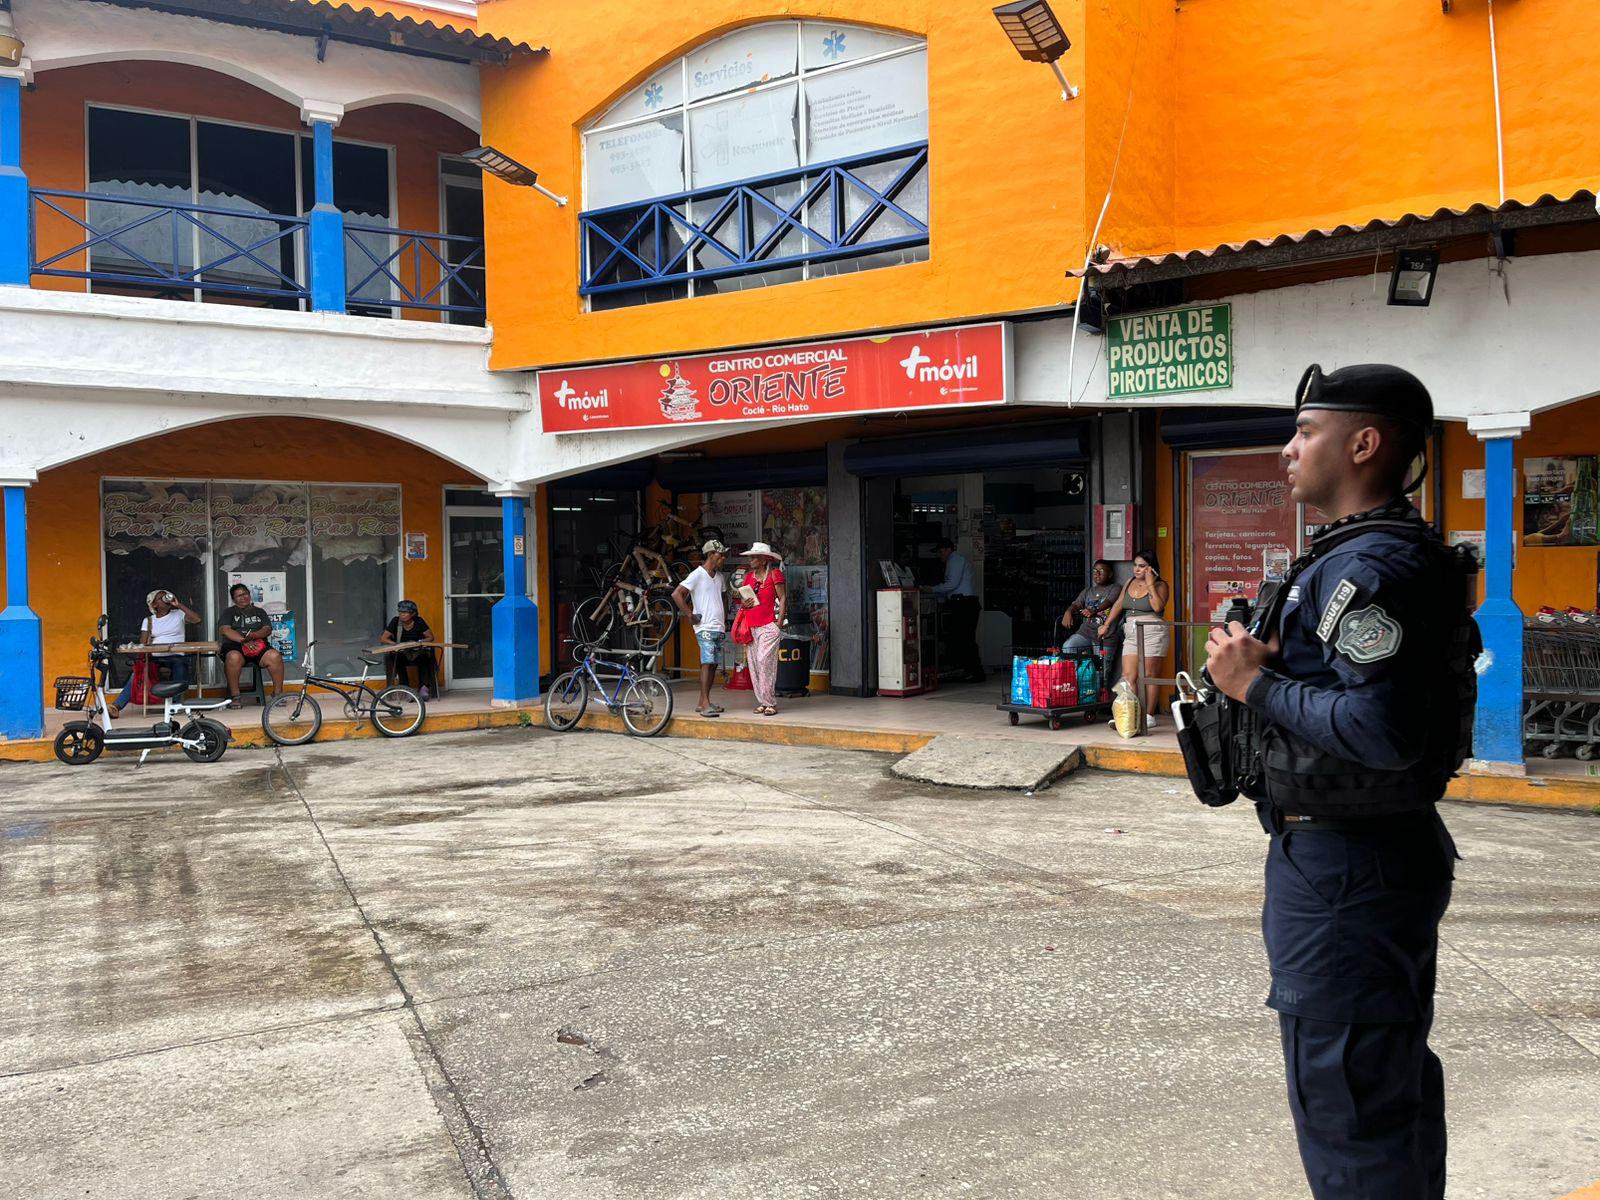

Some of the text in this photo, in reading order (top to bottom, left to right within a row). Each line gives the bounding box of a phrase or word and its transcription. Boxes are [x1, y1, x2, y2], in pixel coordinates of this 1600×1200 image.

[1120, 309, 1213, 341] VENTA DE
[708, 348, 848, 374] CENTRO COMERCIAL
[1110, 333, 1227, 369] PRODUCTOS
[708, 363, 847, 406] ORIENTE
[1110, 360, 1228, 394] PIROTÉCNICOS
[742, 405, 765, 416] Coclé
[787, 403, 809, 411] Hato
[1205, 481, 1287, 490] CENTRO COMERCIAL
[1205, 489, 1287, 508] ORIENTE
[109, 516, 208, 539] Pan Rico
[215, 517, 307, 538] Pan Rico
[313, 517, 400, 536] Pan Rico
[1337, 586, 1350, 601] 1:9
